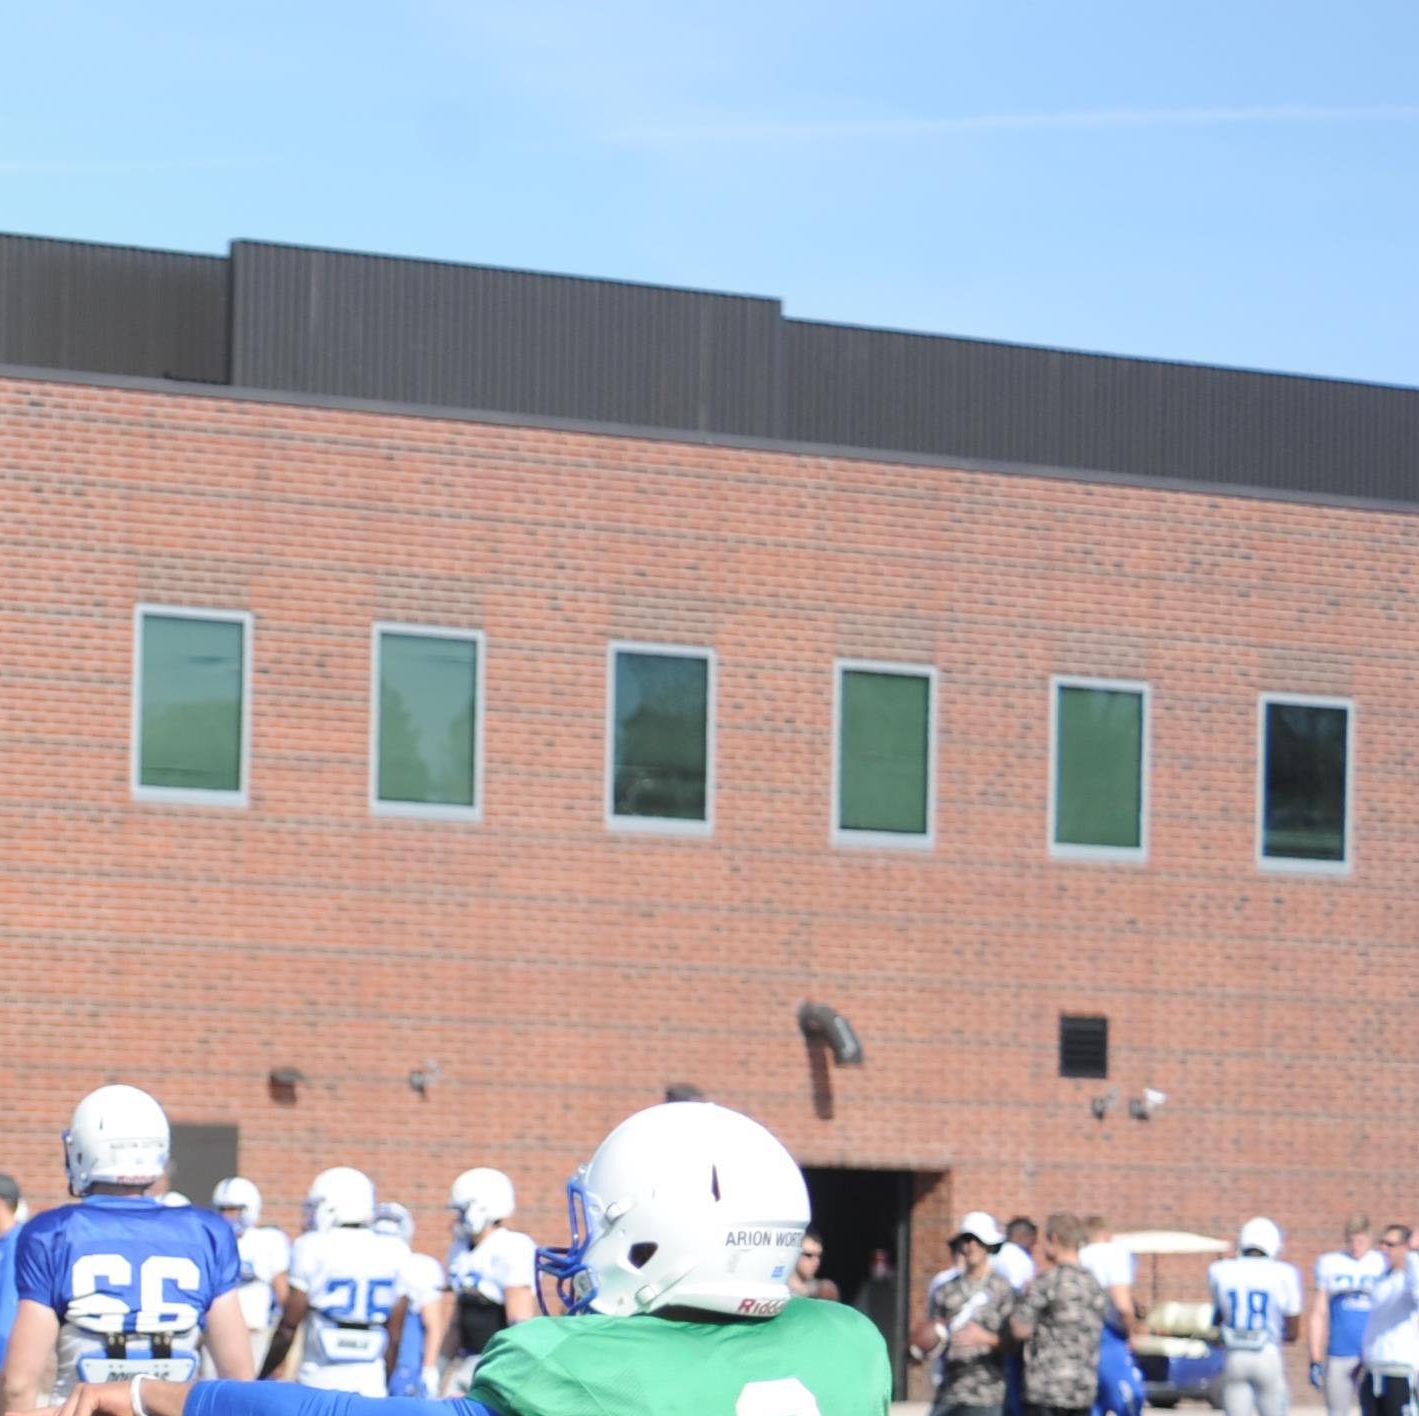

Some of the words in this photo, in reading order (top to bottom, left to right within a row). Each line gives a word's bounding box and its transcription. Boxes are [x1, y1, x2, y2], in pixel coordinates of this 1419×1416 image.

[725, 1230, 771, 1247] ARION
[64, 1254, 200, 1334] 66
[1227, 1290, 1269, 1331] 18
